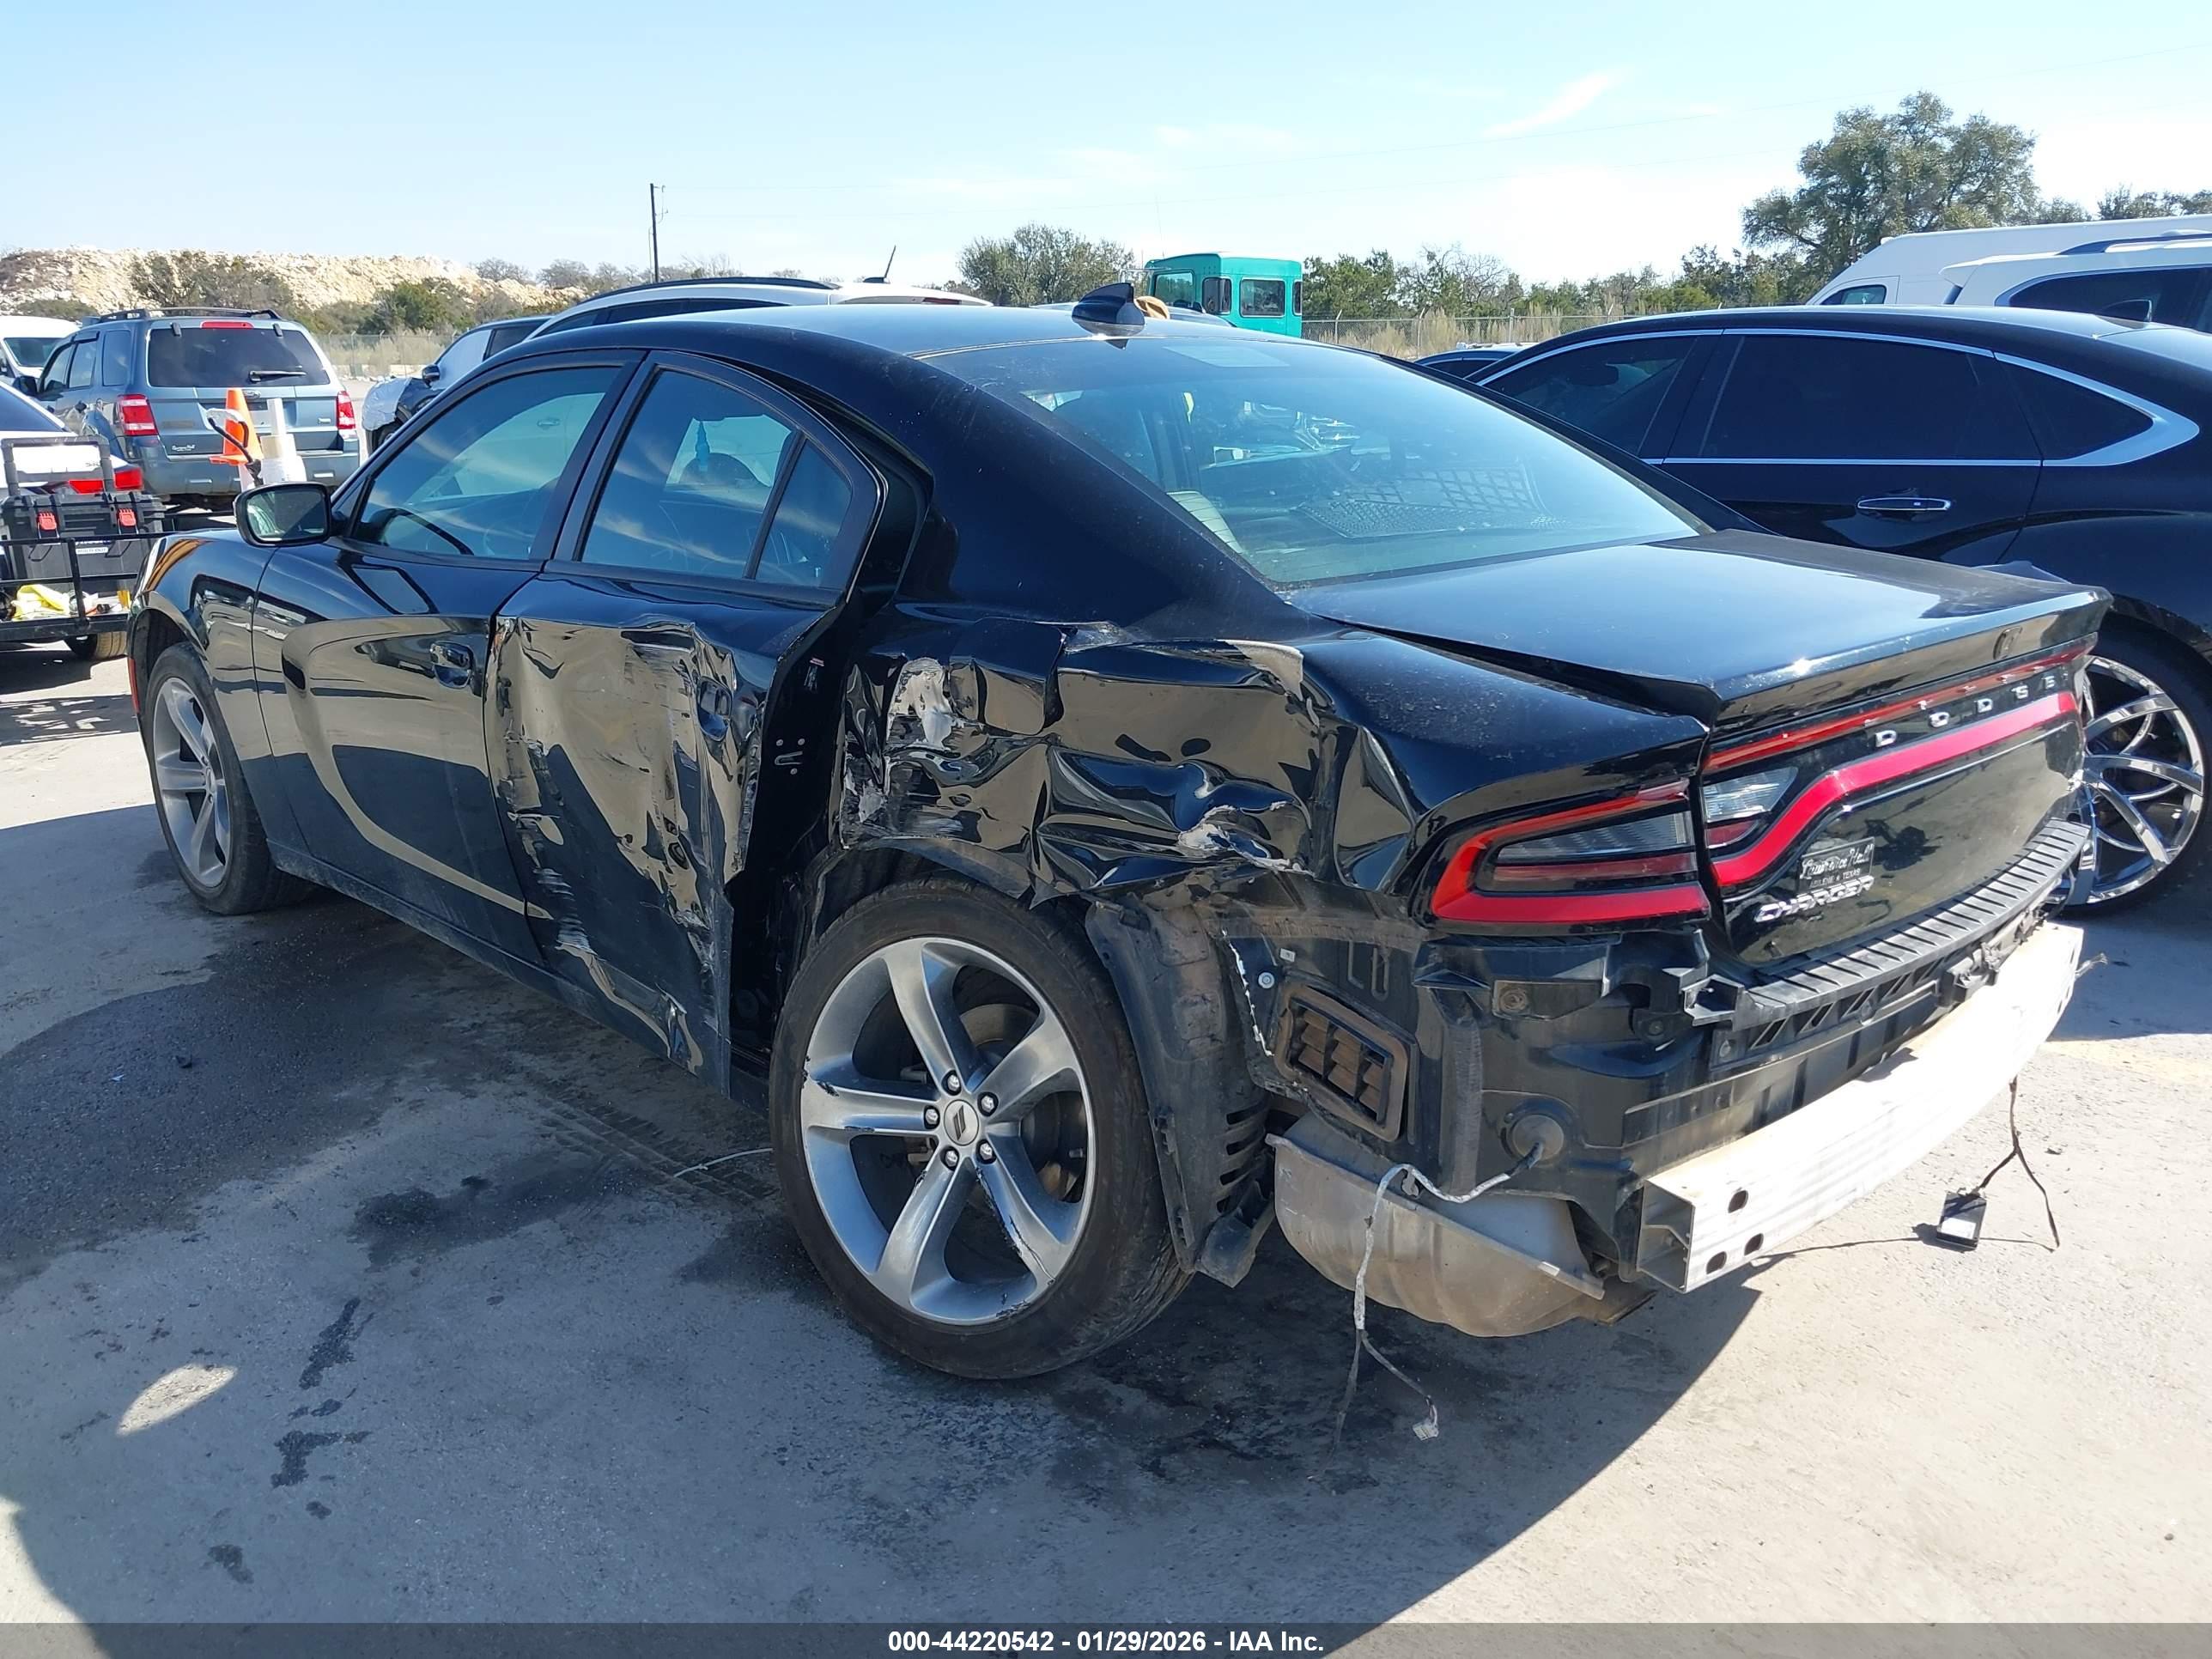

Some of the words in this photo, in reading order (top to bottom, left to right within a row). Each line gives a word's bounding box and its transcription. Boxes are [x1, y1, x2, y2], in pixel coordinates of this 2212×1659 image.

[1875, 675, 2055, 748] DODGE
[1842, 867, 1862, 879] TEXAS
[1753, 874, 1875, 923] CHARGER
